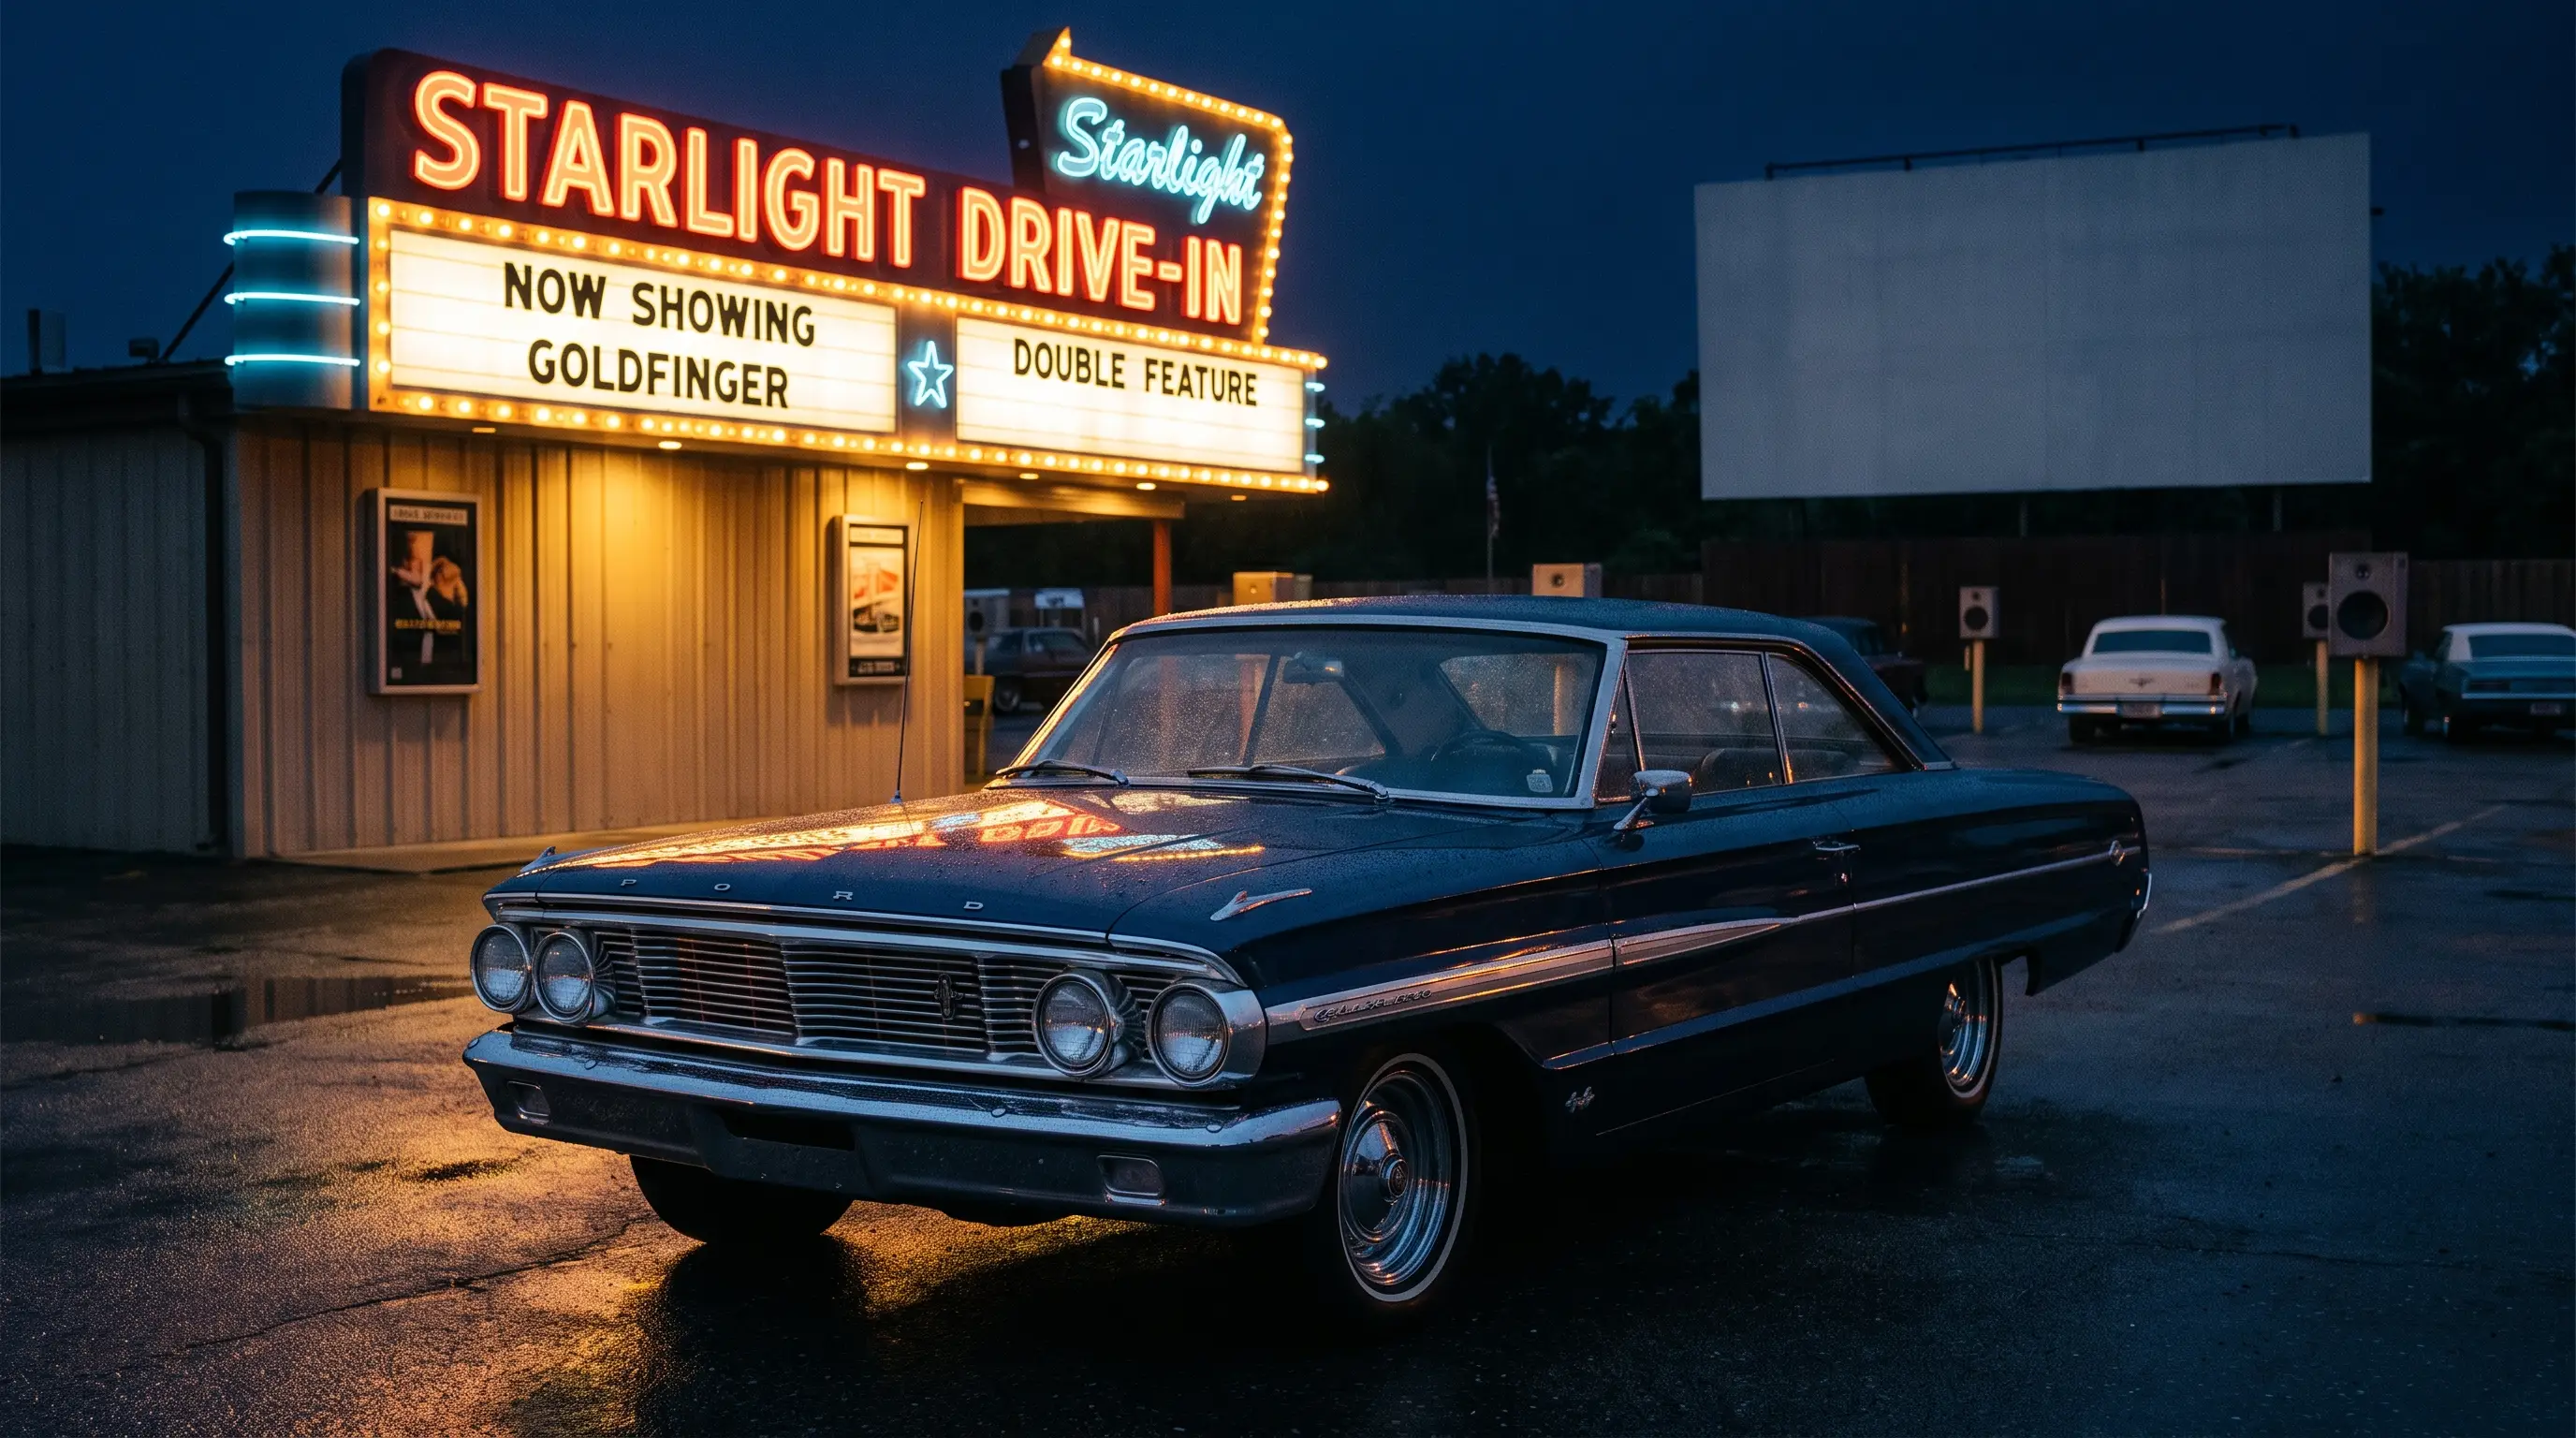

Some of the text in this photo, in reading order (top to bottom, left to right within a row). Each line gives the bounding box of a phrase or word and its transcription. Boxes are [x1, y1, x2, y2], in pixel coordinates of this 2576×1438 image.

[412, 70, 1243, 326] STARLIGHT DRIVE-IN
[1057, 96, 1266, 224] Starlight
[504, 262, 815, 347] NOW SHOWING
[528, 339, 788, 408] GOLDFINGER
[1014, 339, 1257, 406] DOUBLE FEATURE
